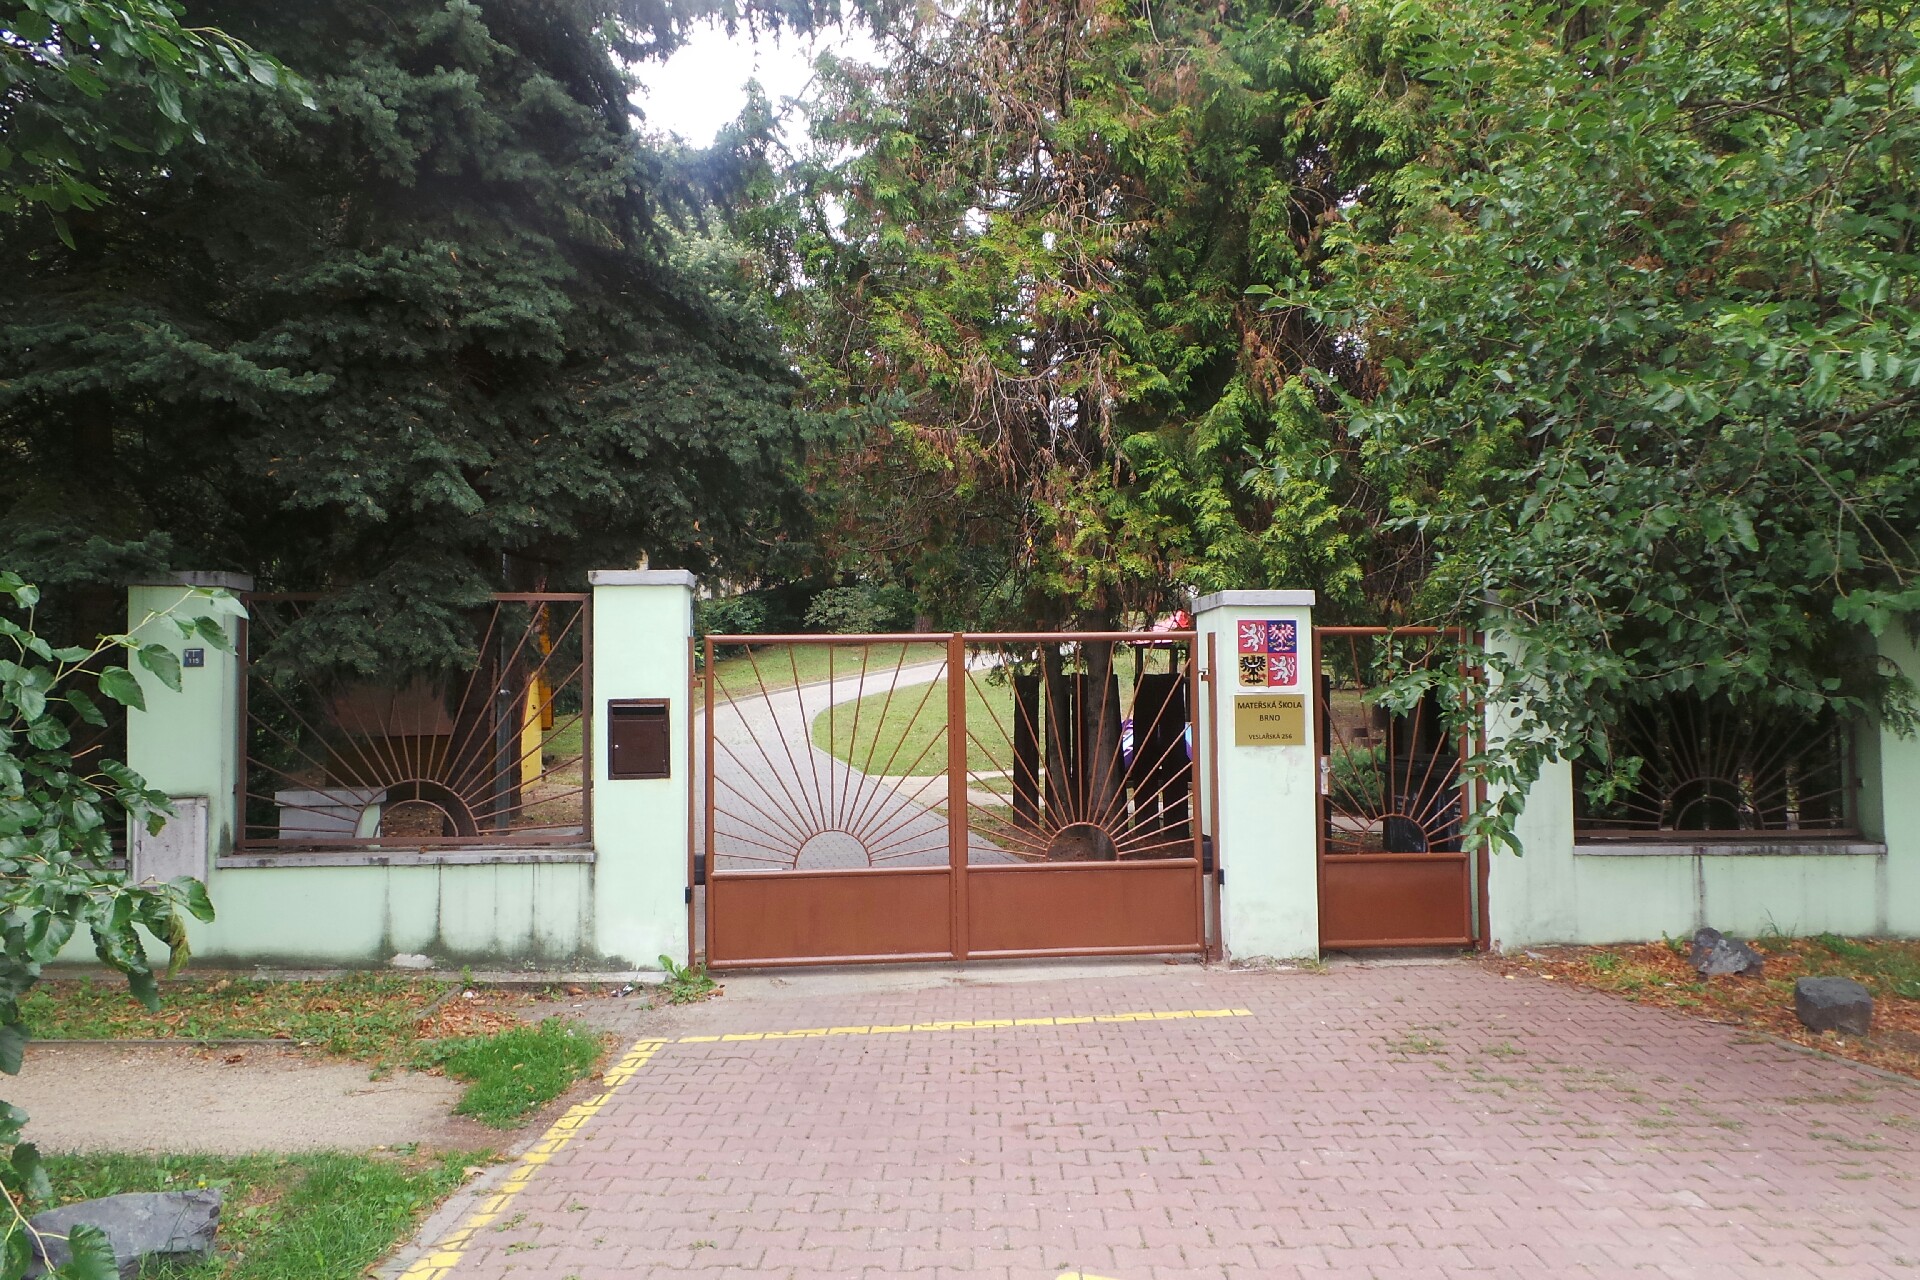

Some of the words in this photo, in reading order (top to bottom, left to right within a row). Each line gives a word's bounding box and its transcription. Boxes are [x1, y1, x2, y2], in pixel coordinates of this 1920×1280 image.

[1237, 701, 1277, 709] MATEŘSKÁ
[1278, 700, 1303, 709] ŠKOLA
[1259, 714, 1281, 722] BRNO
[1248, 732, 1280, 740] VESLAŘSKÁ
